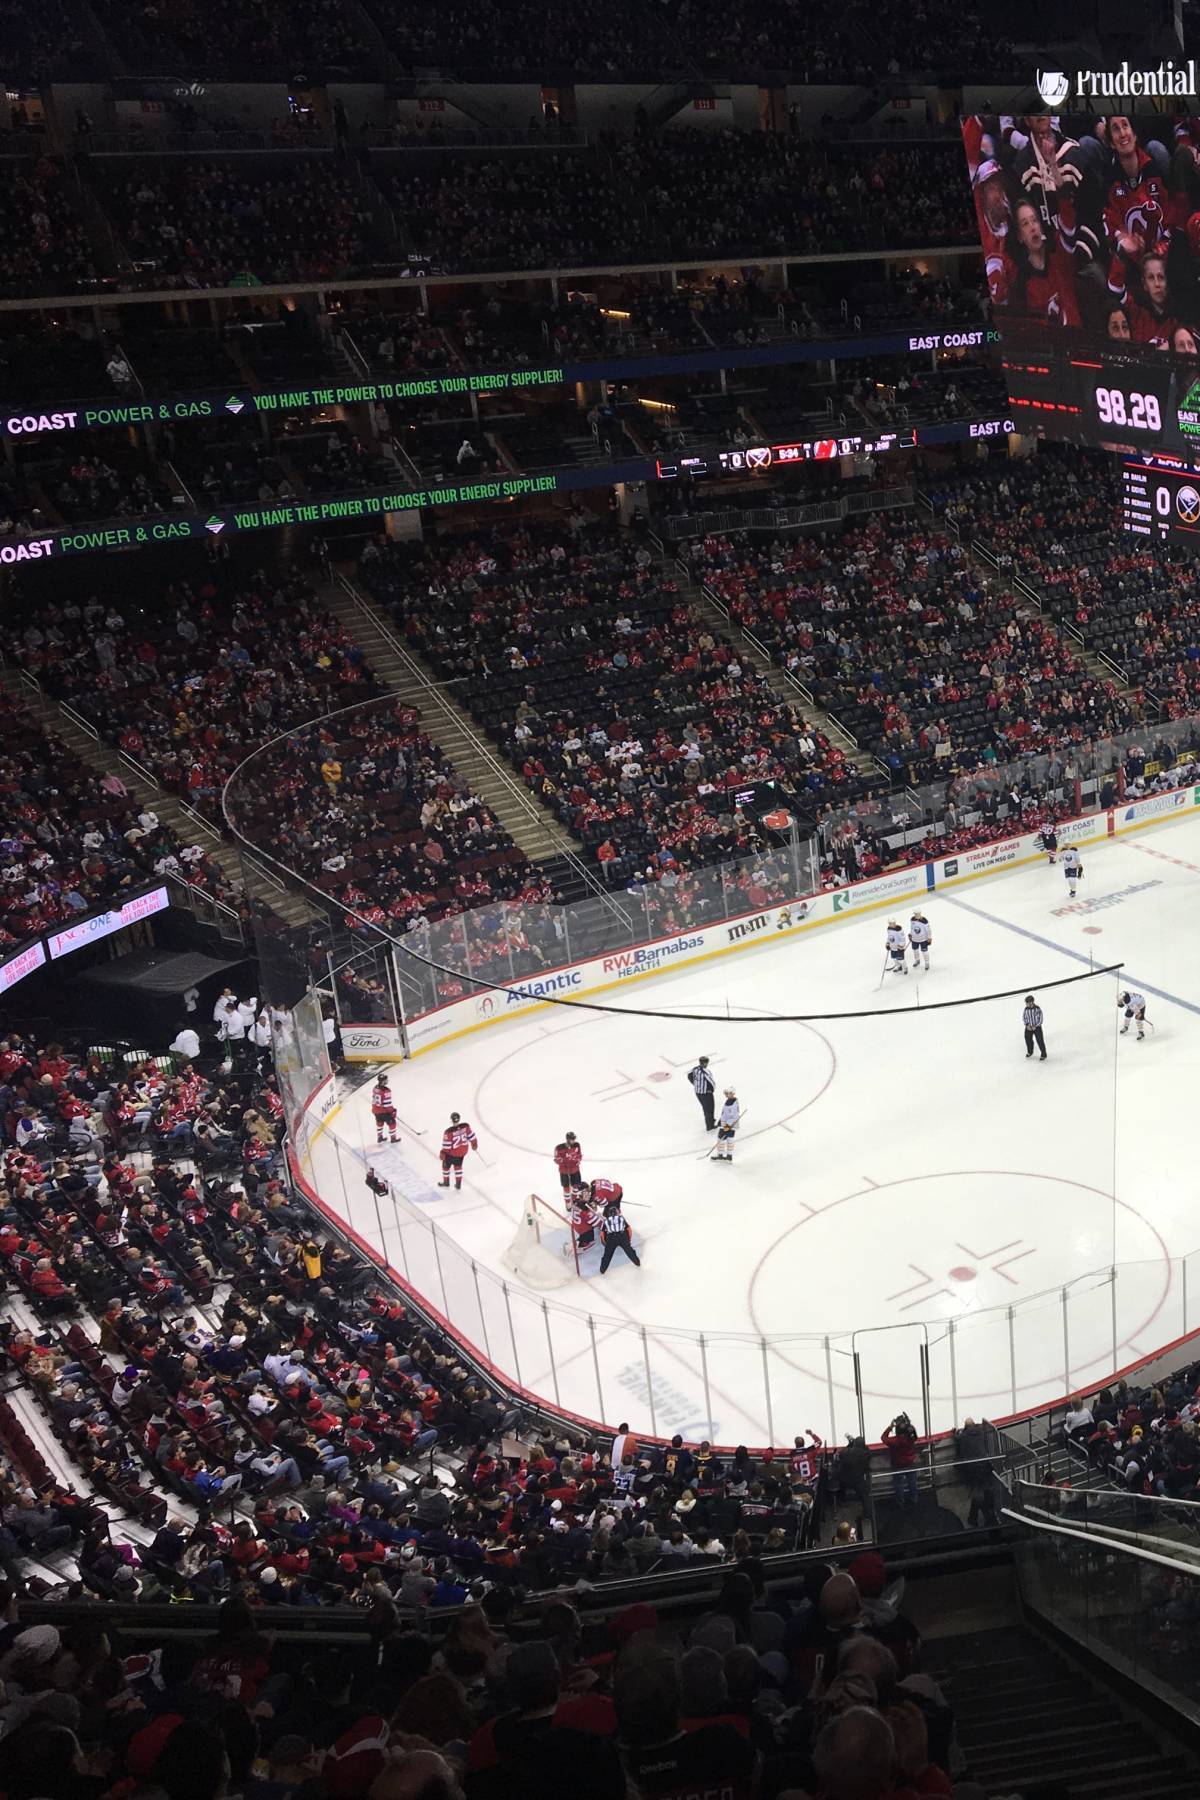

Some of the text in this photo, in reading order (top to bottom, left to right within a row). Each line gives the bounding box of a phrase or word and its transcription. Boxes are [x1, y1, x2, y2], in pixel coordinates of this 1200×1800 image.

[1076, 61, 1197, 97] Prudential
[909, 336, 941, 350] EAST
[943, 332, 984, 347] COAST
[253, 368, 563, 411] YOU HAVE THE POWER TO CHOOSE YOUR ENERGY SUPPLIER!
[7, 401, 212, 435] COAST POWER & GAS
[1177, 409, 1198, 423] EAST
[969, 421, 1000, 437] EAST
[778, 447, 799, 460] 5:34
[841, 440, 850, 453] 0
[732, 454, 741, 467] 0
[234, 475, 557, 529] YOU HAVE THE POWER TO CHOOSE YOUR ENERGY SUPPLIER!
[1156, 486, 1170, 515] 0
[60, 529, 130, 552] POWER
[136, 527, 149, 542] &
[152, 521, 191, 539] GAS
[1072, 818, 1095, 831] COAST
[966, 842, 1020, 863] STREAM GAMES
[973, 860, 986, 870] LIVE
[986, 858, 995, 866] ON
[852, 885, 880, 898] Riverside
[880, 882, 893, 891] Oral
[893, 875, 917, 887] Surgery
[146, 901, 161, 912] LOVE
[89, 912, 112, 931] ONE
[618, 959, 661, 979] HEALTH
[506, 971, 582, 1004] Atlantic
[350, 1034, 381, 1047] Ford
